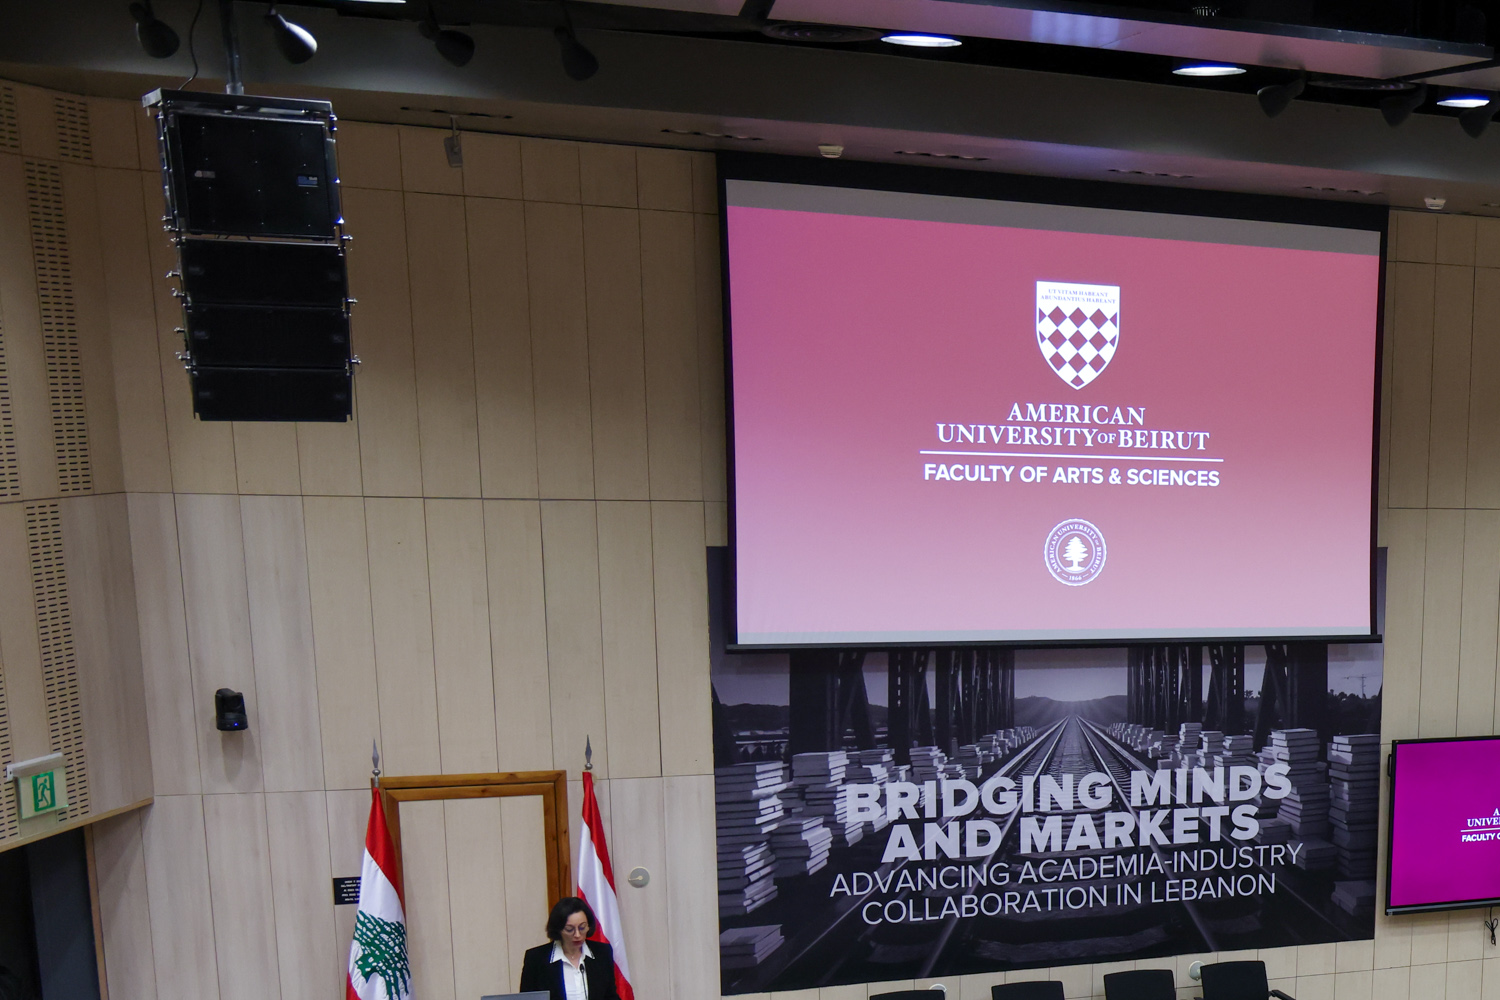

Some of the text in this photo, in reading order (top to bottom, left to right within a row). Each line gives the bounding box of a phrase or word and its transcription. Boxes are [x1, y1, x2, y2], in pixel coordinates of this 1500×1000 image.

[1006, 402, 1146, 425] AMERICAN
[936, 423, 1210, 450] UNIVERSITY OF BEIRUT
[923, 463, 1220, 487] FACULTY OF ARTS & SCIENCES
[1057, 524, 1097, 539] UNIVERSITY
[845, 764, 1293, 823] BRIDGING MINDS
[881, 804, 1260, 863] AND MARKETS
[1461, 832, 1495, 842] FACULTY
[829, 843, 1304, 898] ADVANCING ACADEMIA-INDUSTRY
[861, 873, 1277, 925] COLLABORATION IN LEBANON
